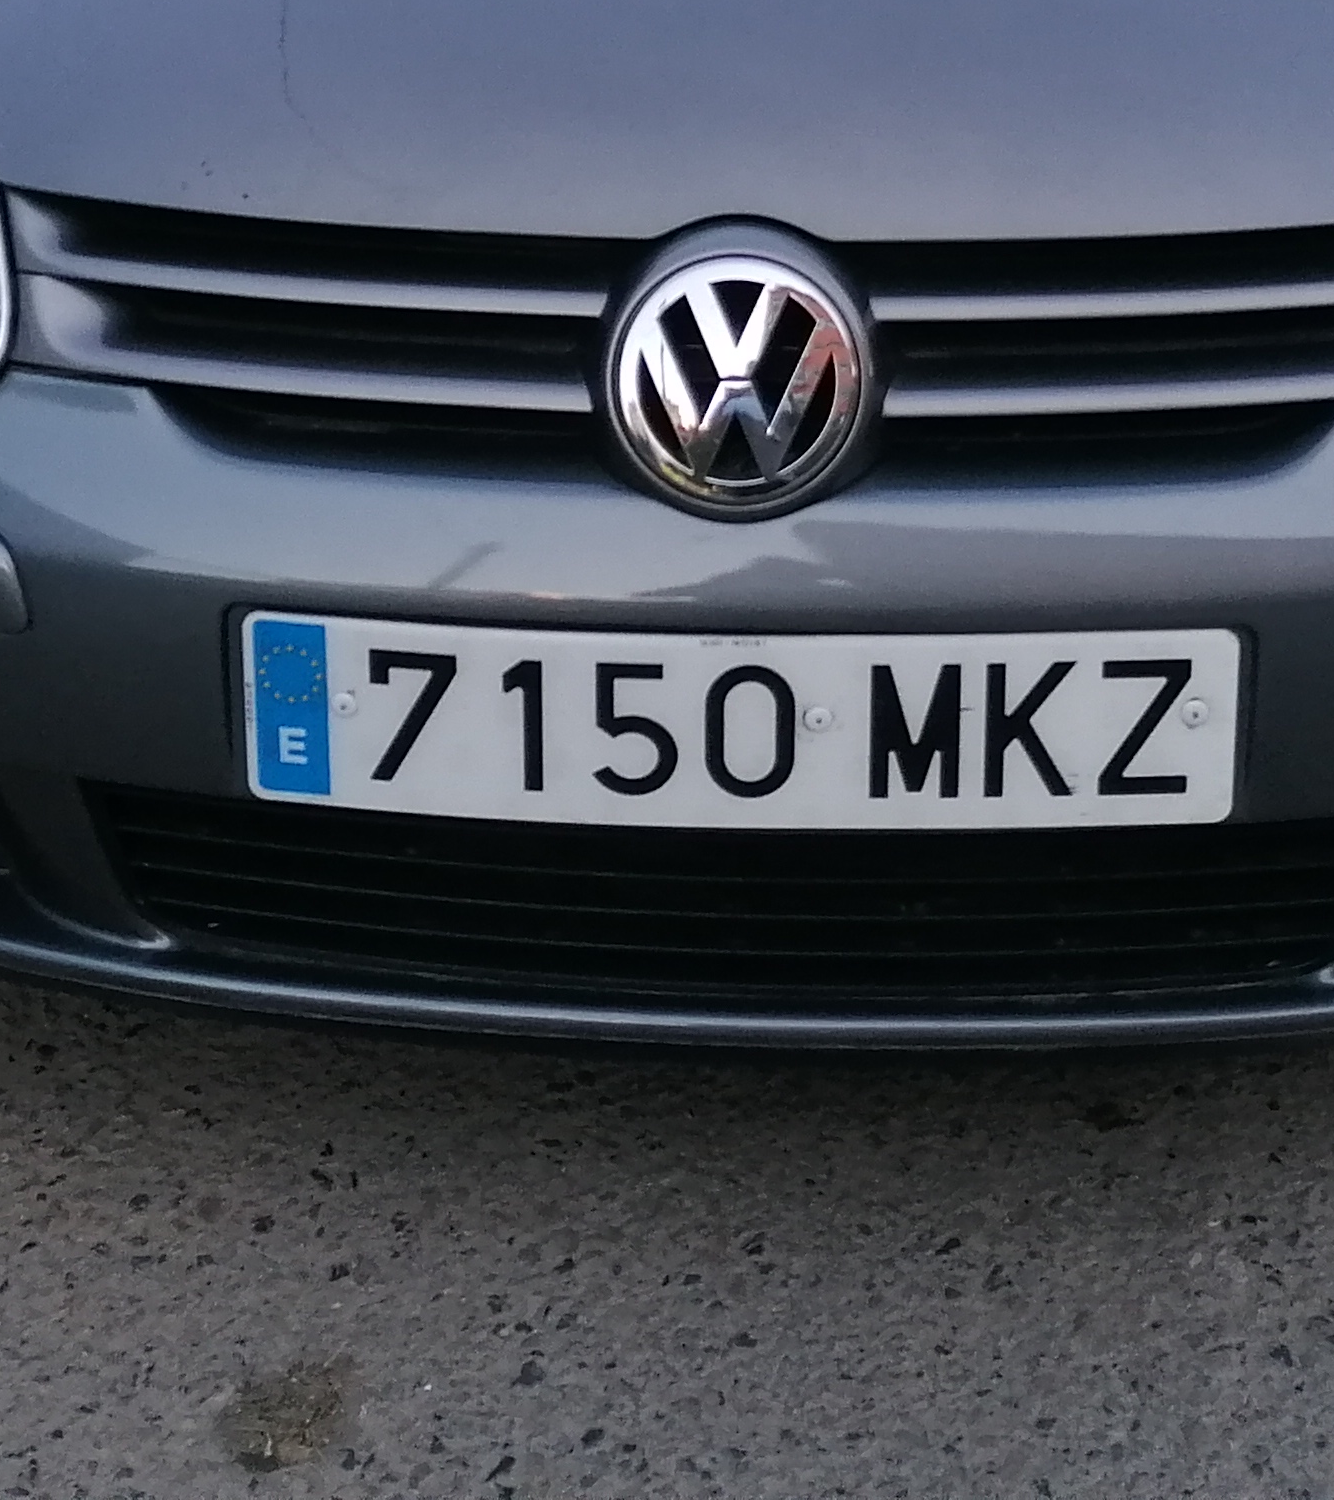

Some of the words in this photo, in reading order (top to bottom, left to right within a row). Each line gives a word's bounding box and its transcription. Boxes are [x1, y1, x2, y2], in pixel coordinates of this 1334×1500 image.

[279, 726, 308, 765] E
[368, 649, 796, 799] 7150
[870, 658, 1194, 799] MKZ
